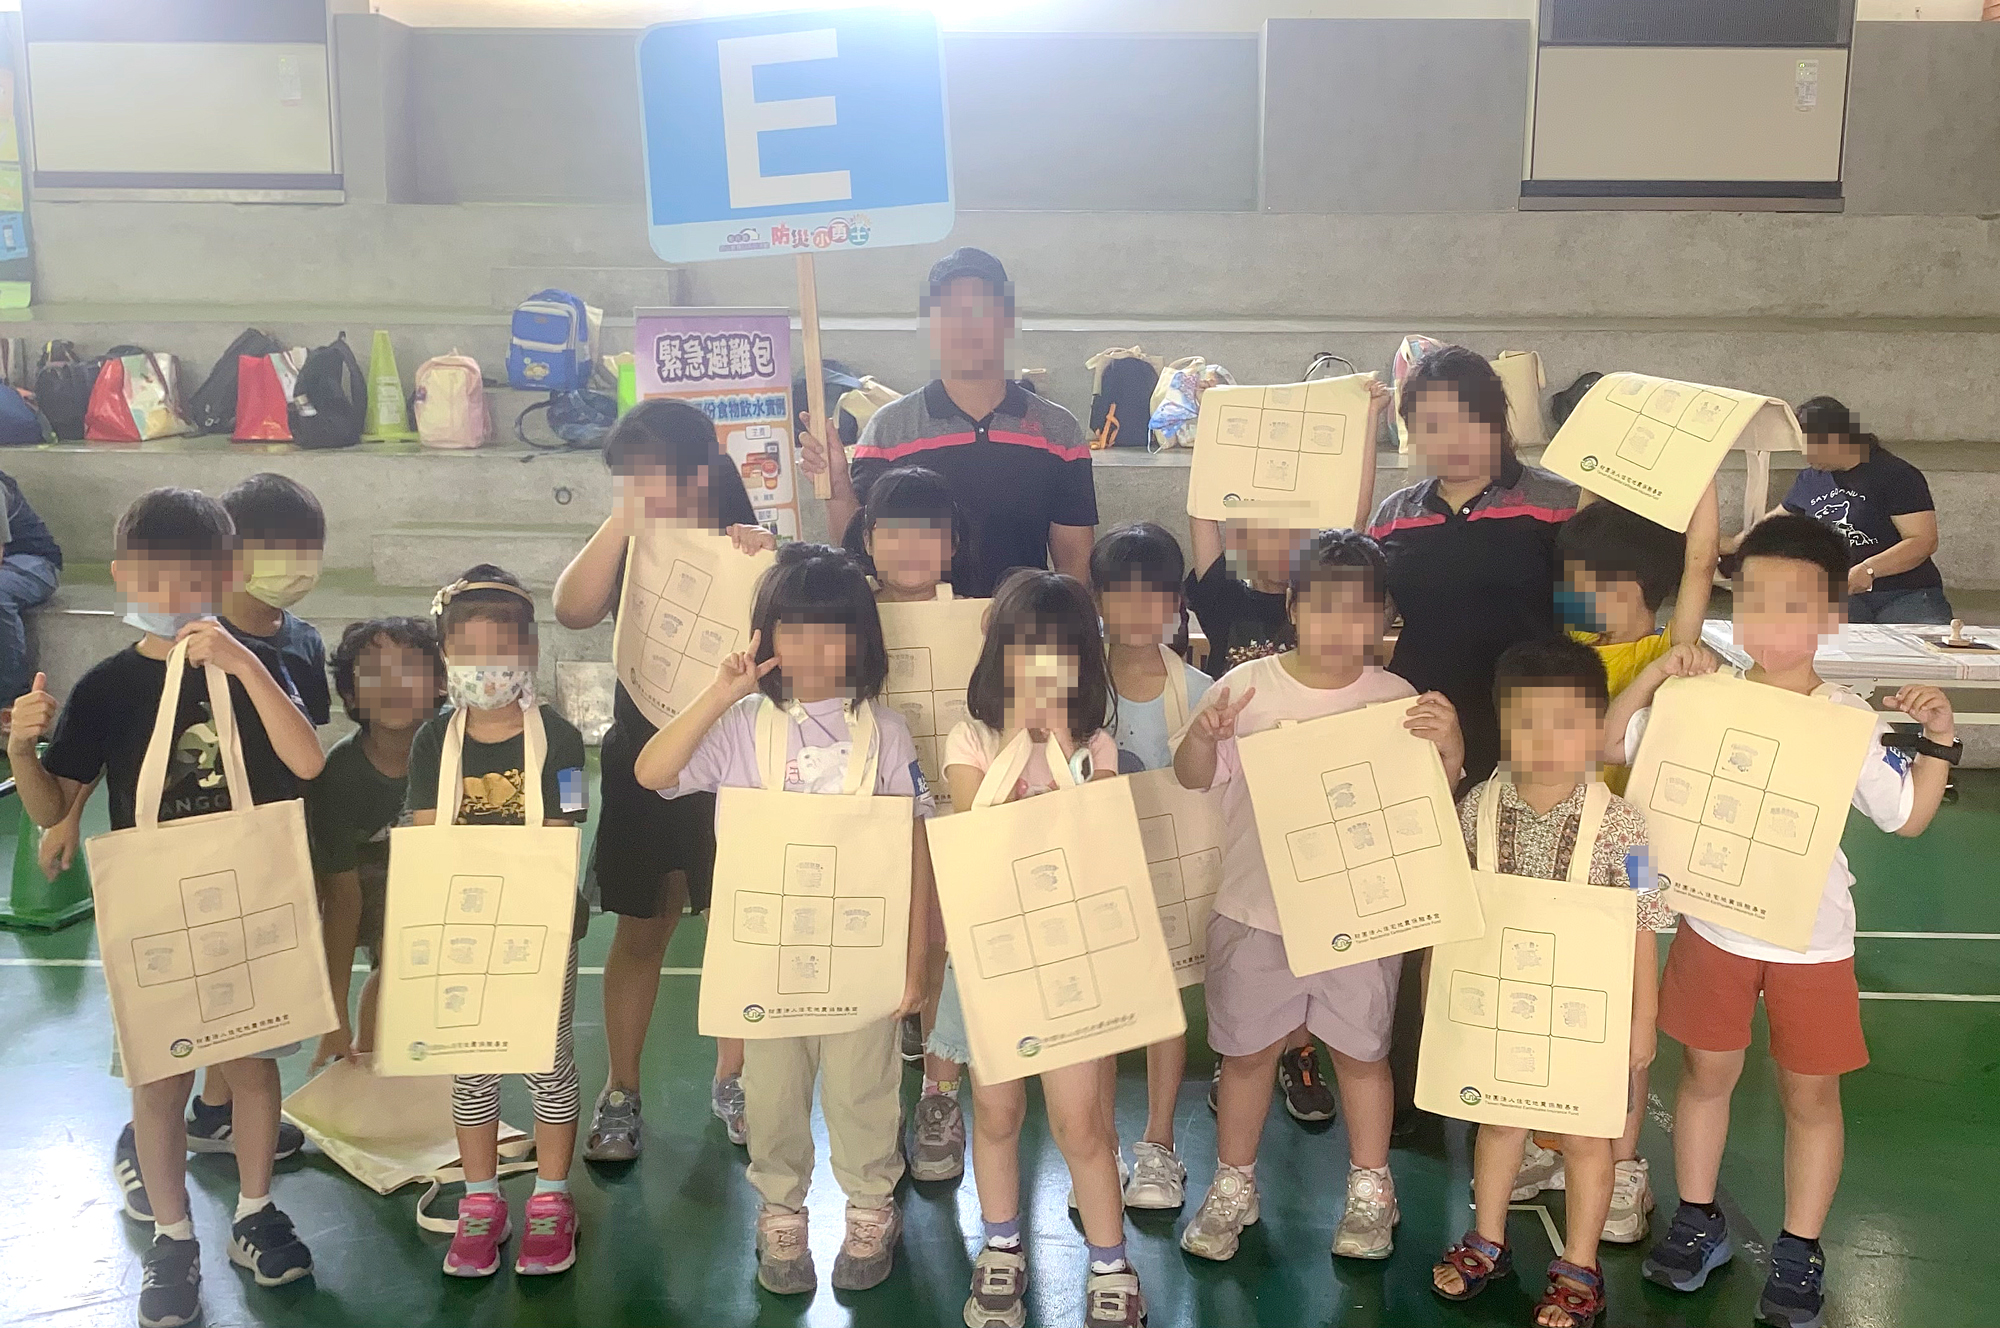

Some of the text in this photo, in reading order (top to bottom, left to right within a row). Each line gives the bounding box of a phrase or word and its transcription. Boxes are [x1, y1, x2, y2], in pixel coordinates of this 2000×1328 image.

[718, 28, 852, 209] E
[771, 218, 870, 249] 防災小勇士
[657, 336, 775, 381] 緊急避難包
[698, 396, 787, 418] 份食物飲水實例
[1810, 493, 1828, 506] SAY
